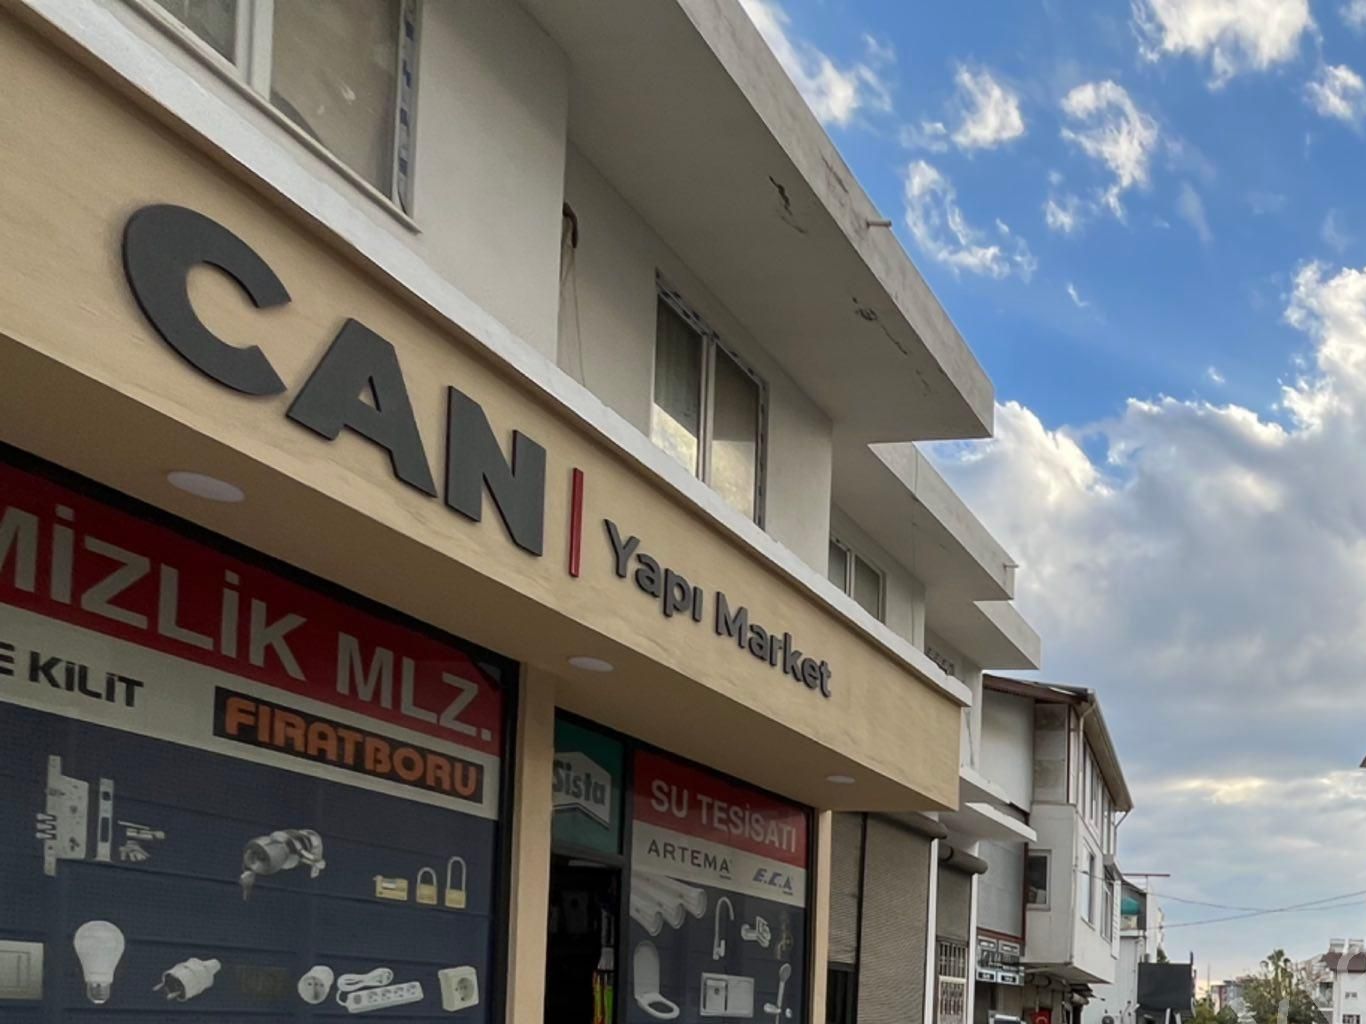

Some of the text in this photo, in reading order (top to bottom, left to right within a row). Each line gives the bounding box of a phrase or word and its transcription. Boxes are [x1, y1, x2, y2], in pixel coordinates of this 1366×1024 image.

[122, 203, 832, 698] CAN Yapı Market
[29, 650, 144, 707] KİLİT
[336, 631, 492, 742] MLZ.
[225, 696, 477, 796] FIRATBORU
[553, 759, 606, 806] Sista
[651, 780, 796, 853] SU TESİSATI
[648, 839, 730, 874] ARTEMA
